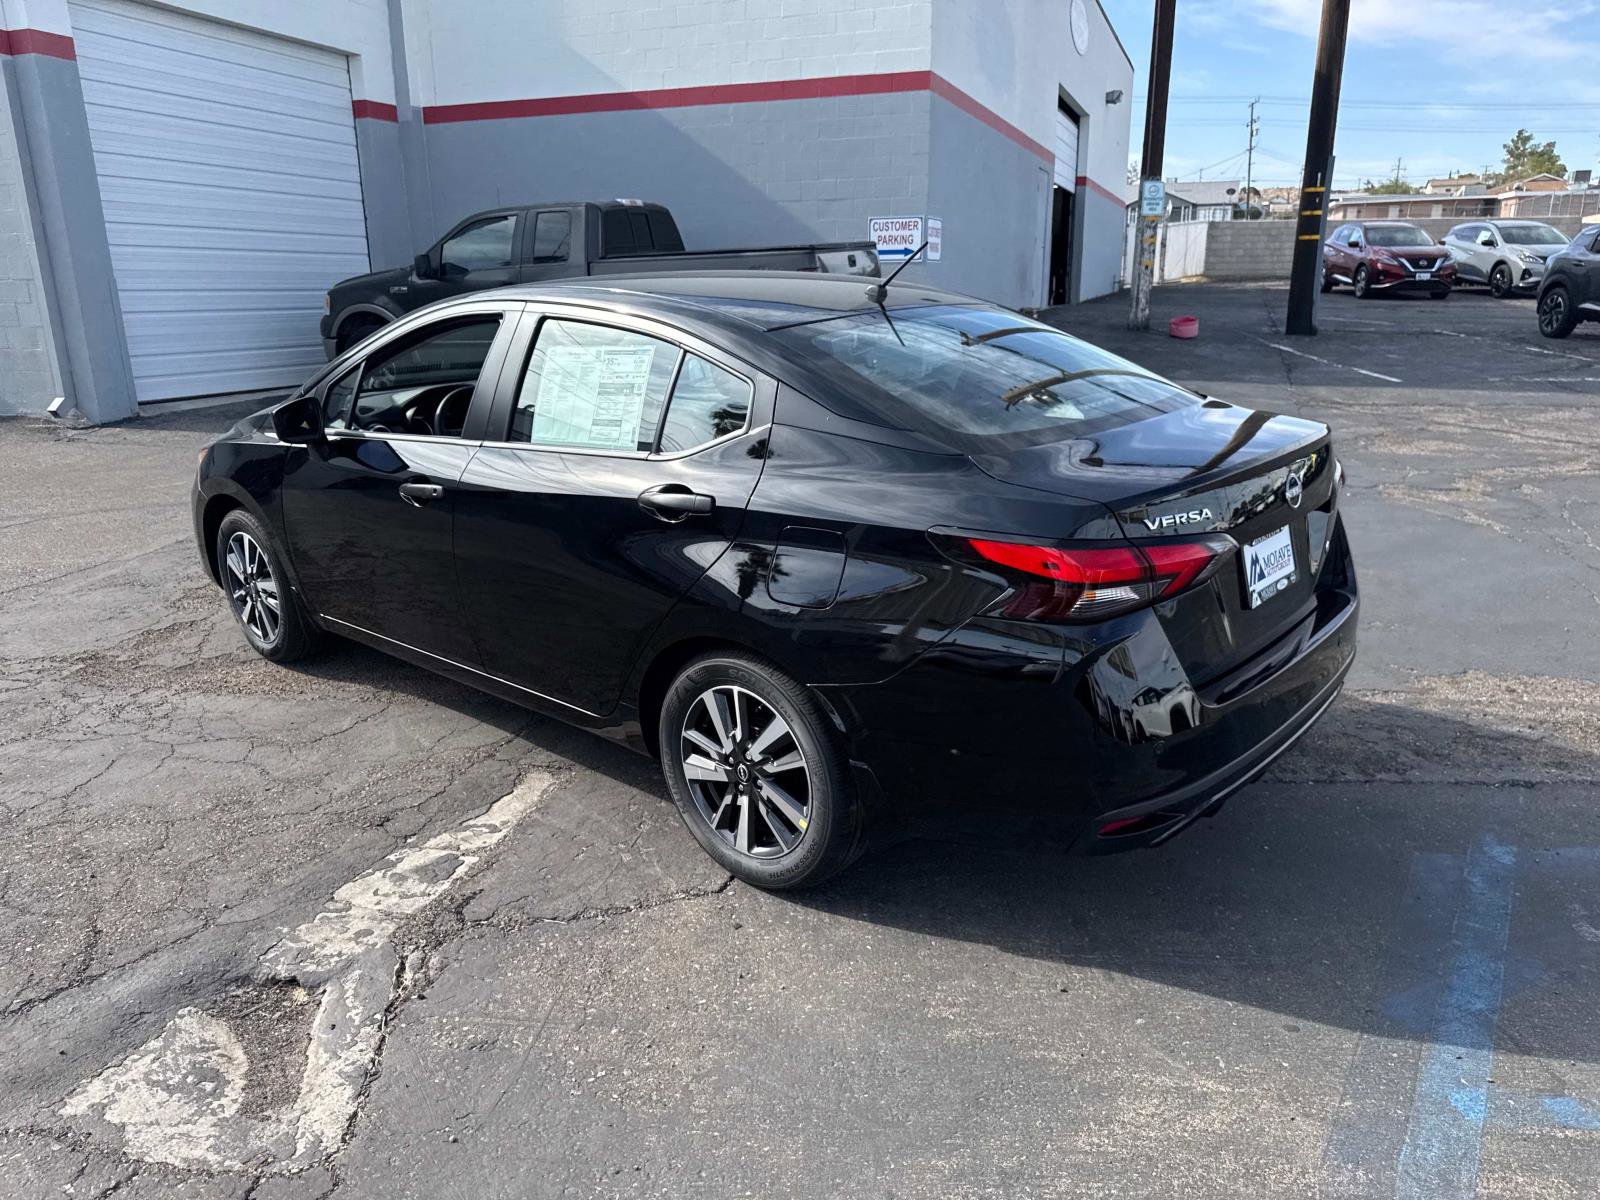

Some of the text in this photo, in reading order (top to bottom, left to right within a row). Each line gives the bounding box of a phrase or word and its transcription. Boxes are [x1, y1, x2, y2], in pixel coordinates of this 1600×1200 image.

[873, 220, 919, 232] CUSTOMER
[877, 234, 914, 246] PARKING
[1143, 508, 1212, 531] VERSA
[1262, 544, 1292, 570] MOJAVE
